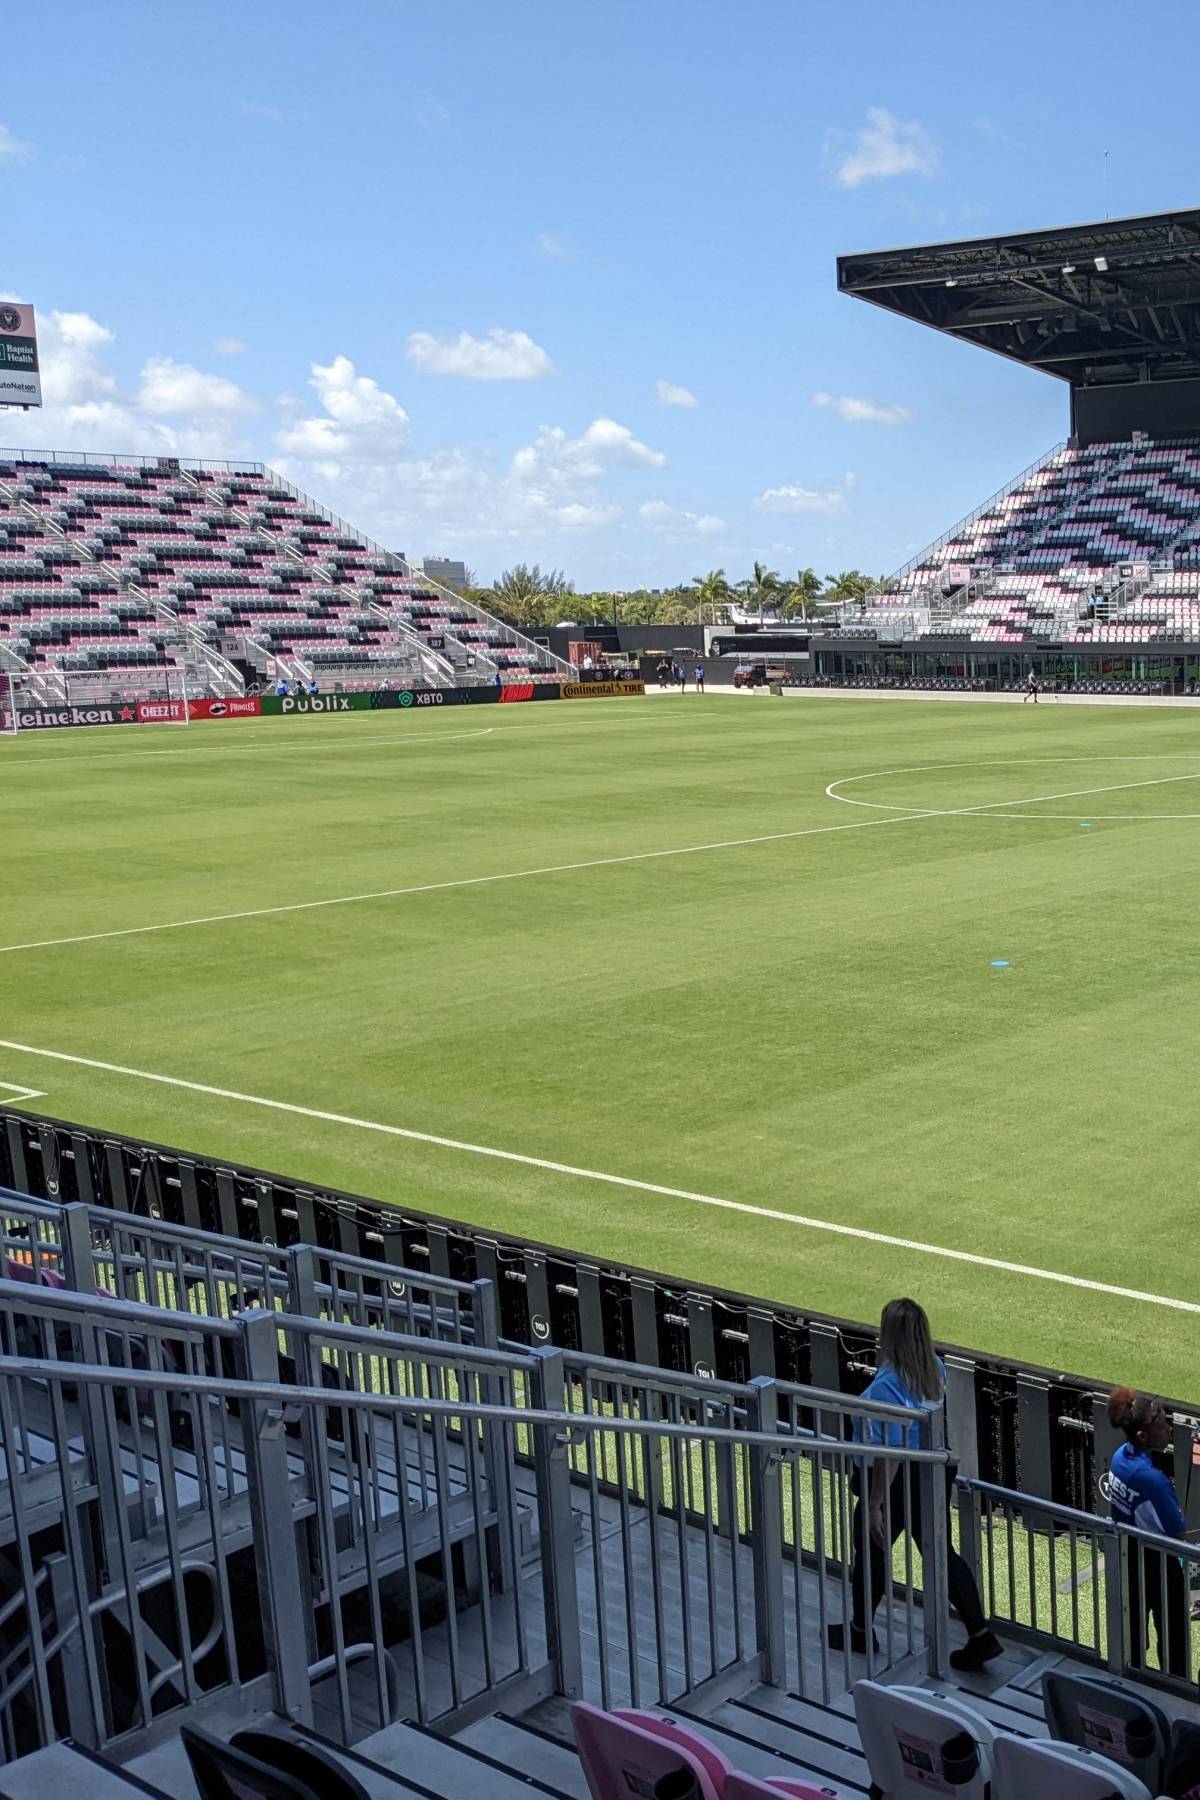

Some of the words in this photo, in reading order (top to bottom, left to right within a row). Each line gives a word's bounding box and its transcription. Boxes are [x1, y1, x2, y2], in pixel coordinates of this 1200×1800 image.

[6, 344, 33, 354] Baptist
[7, 353, 33, 363] Health
[226, 643, 239, 651] 126
[563, 683, 614, 698] Continental
[624, 684, 643, 693] TIRE
[282, 695, 350, 713] Publix
[416, 693, 443, 704] XBTO
[230, 702, 255, 713] PRINGLES
[4, 708, 114, 728] Heineken
